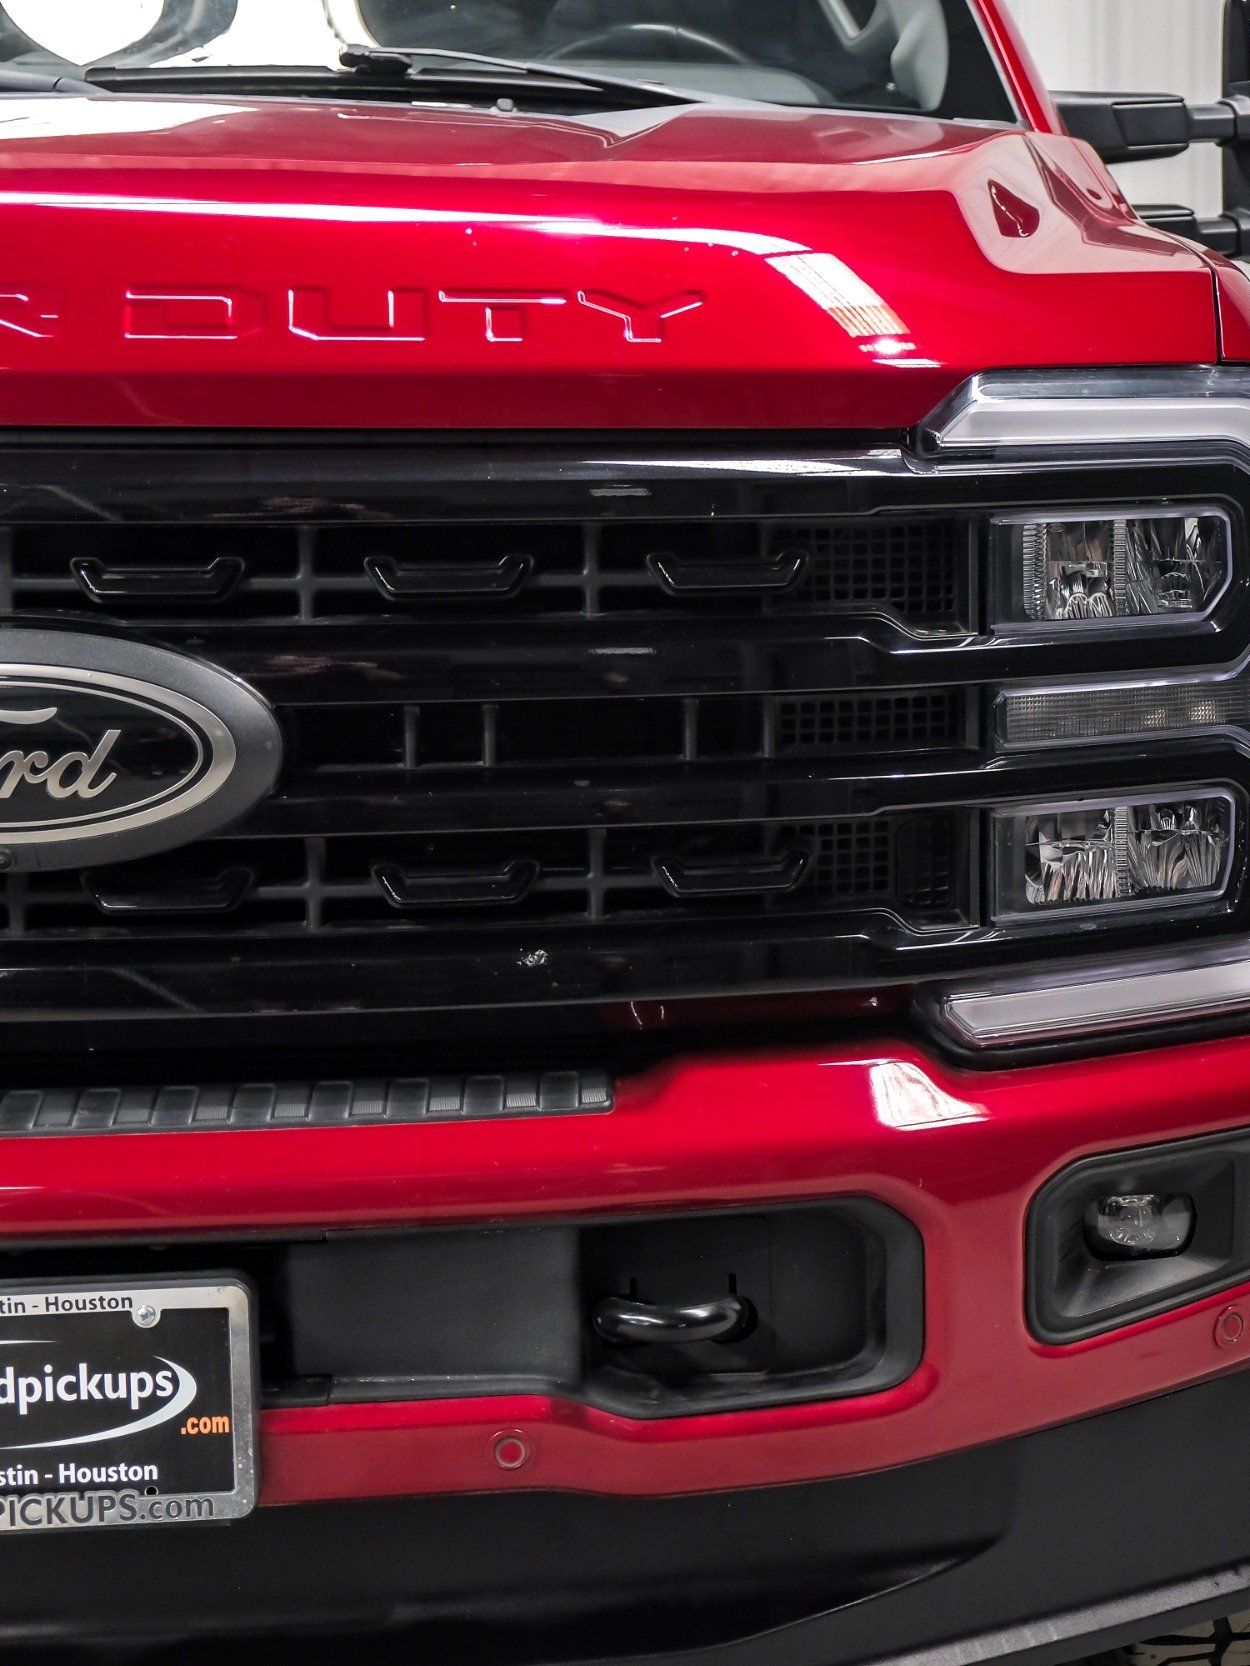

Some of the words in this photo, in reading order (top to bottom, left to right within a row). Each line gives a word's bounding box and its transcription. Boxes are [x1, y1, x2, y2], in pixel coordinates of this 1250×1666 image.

[123, 285, 704, 343] DUTY
[0, 707, 122, 799] rd
[45, 1296, 133, 1312] Houston
[181, 1415, 230, 1435] .com
[59, 1463, 158, 1484] Houston
[0, 1494, 214, 1527] ICKUPS.com
